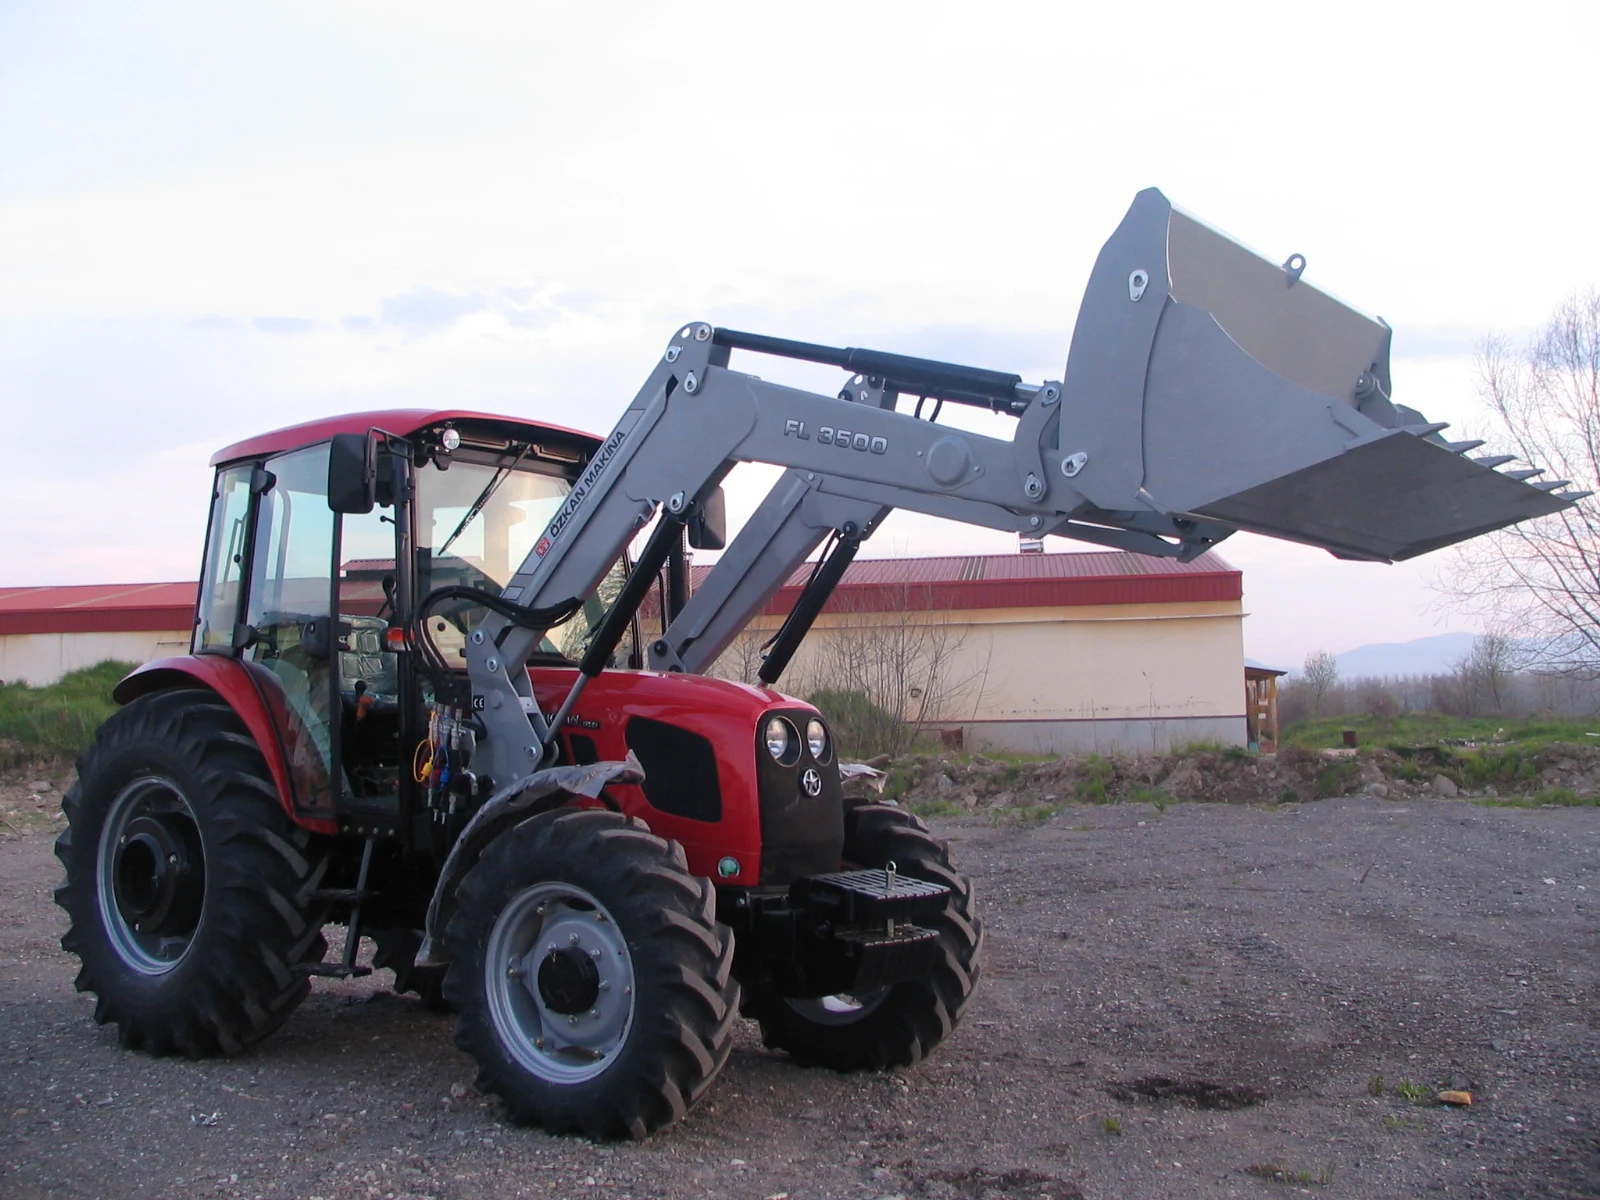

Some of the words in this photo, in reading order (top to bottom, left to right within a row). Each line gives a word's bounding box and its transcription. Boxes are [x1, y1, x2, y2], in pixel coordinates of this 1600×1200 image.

[784, 419, 810, 441] FL
[818, 426, 888, 455] 3500
[550, 487, 586, 537] ÖZKAN
[473, 698, 484, 708] CE
